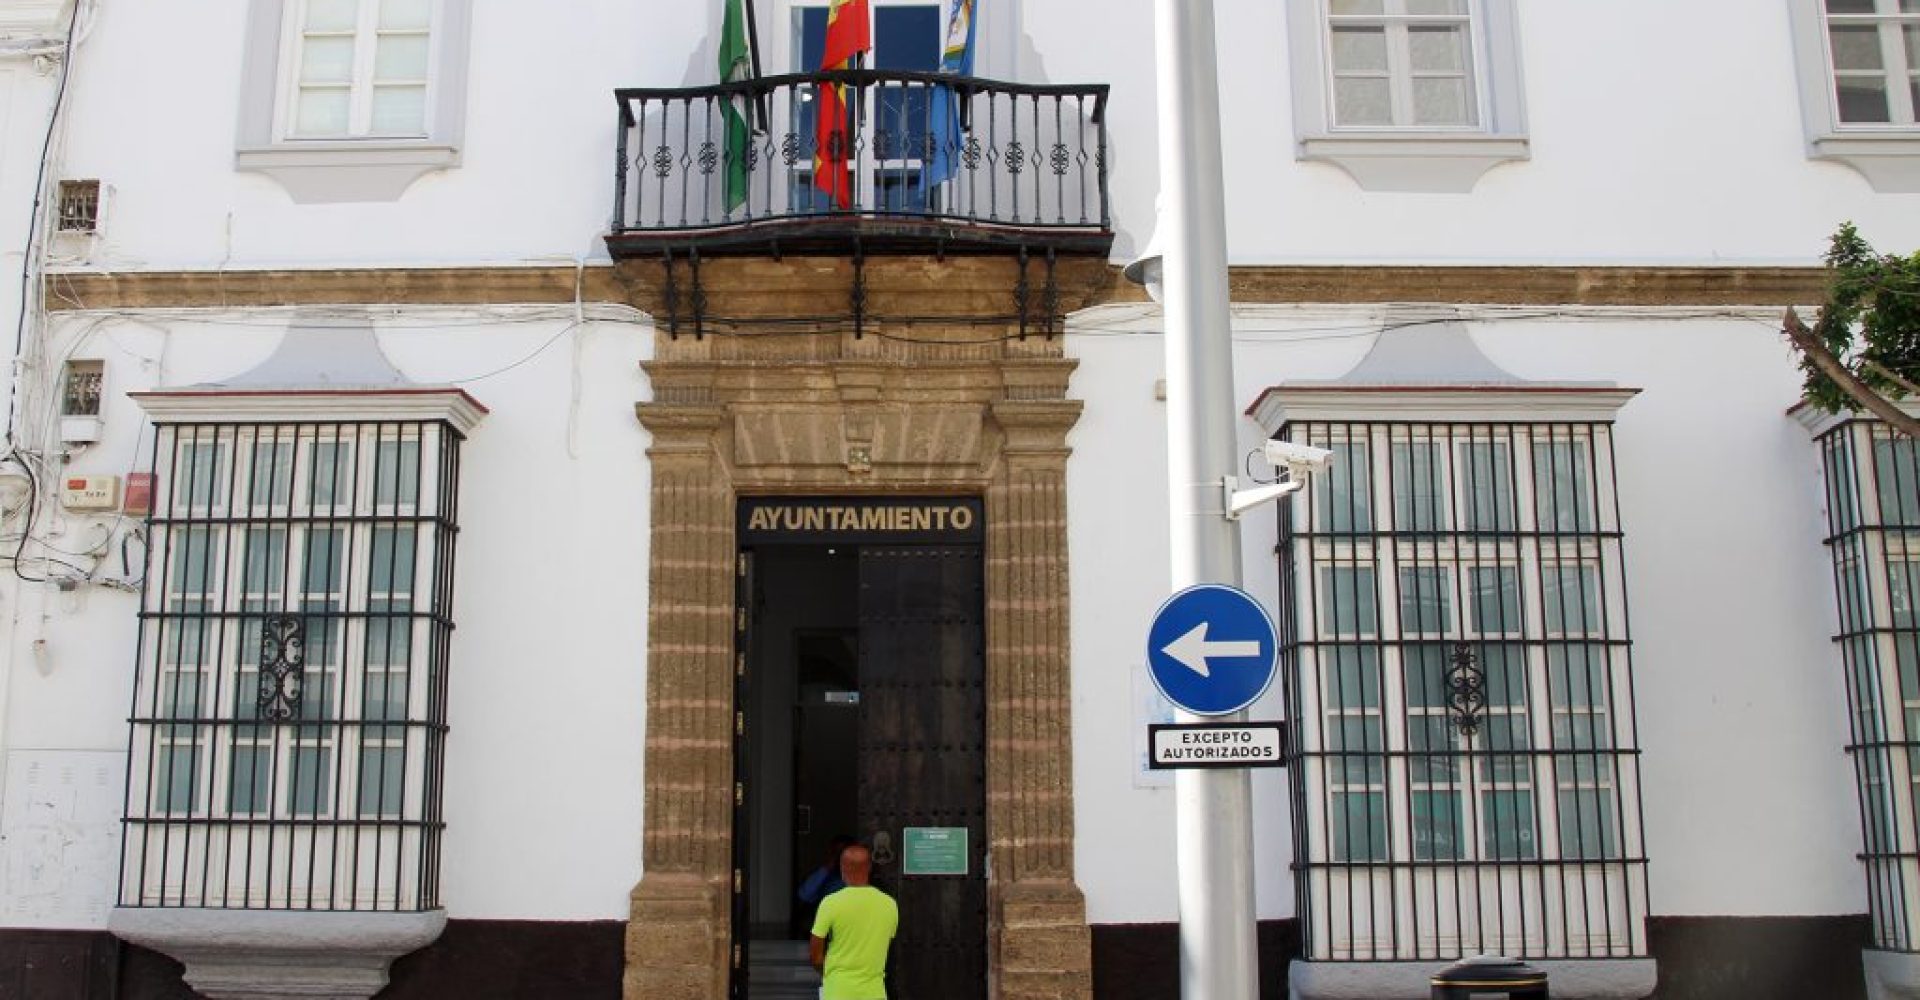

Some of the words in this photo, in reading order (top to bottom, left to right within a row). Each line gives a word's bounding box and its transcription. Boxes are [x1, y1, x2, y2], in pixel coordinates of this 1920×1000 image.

[748, 506, 973, 530] AYUNTAMIENTO
[1182, 732, 1252, 744] EXCEPTO
[1163, 746, 1273, 759] AUTORIZADOS
